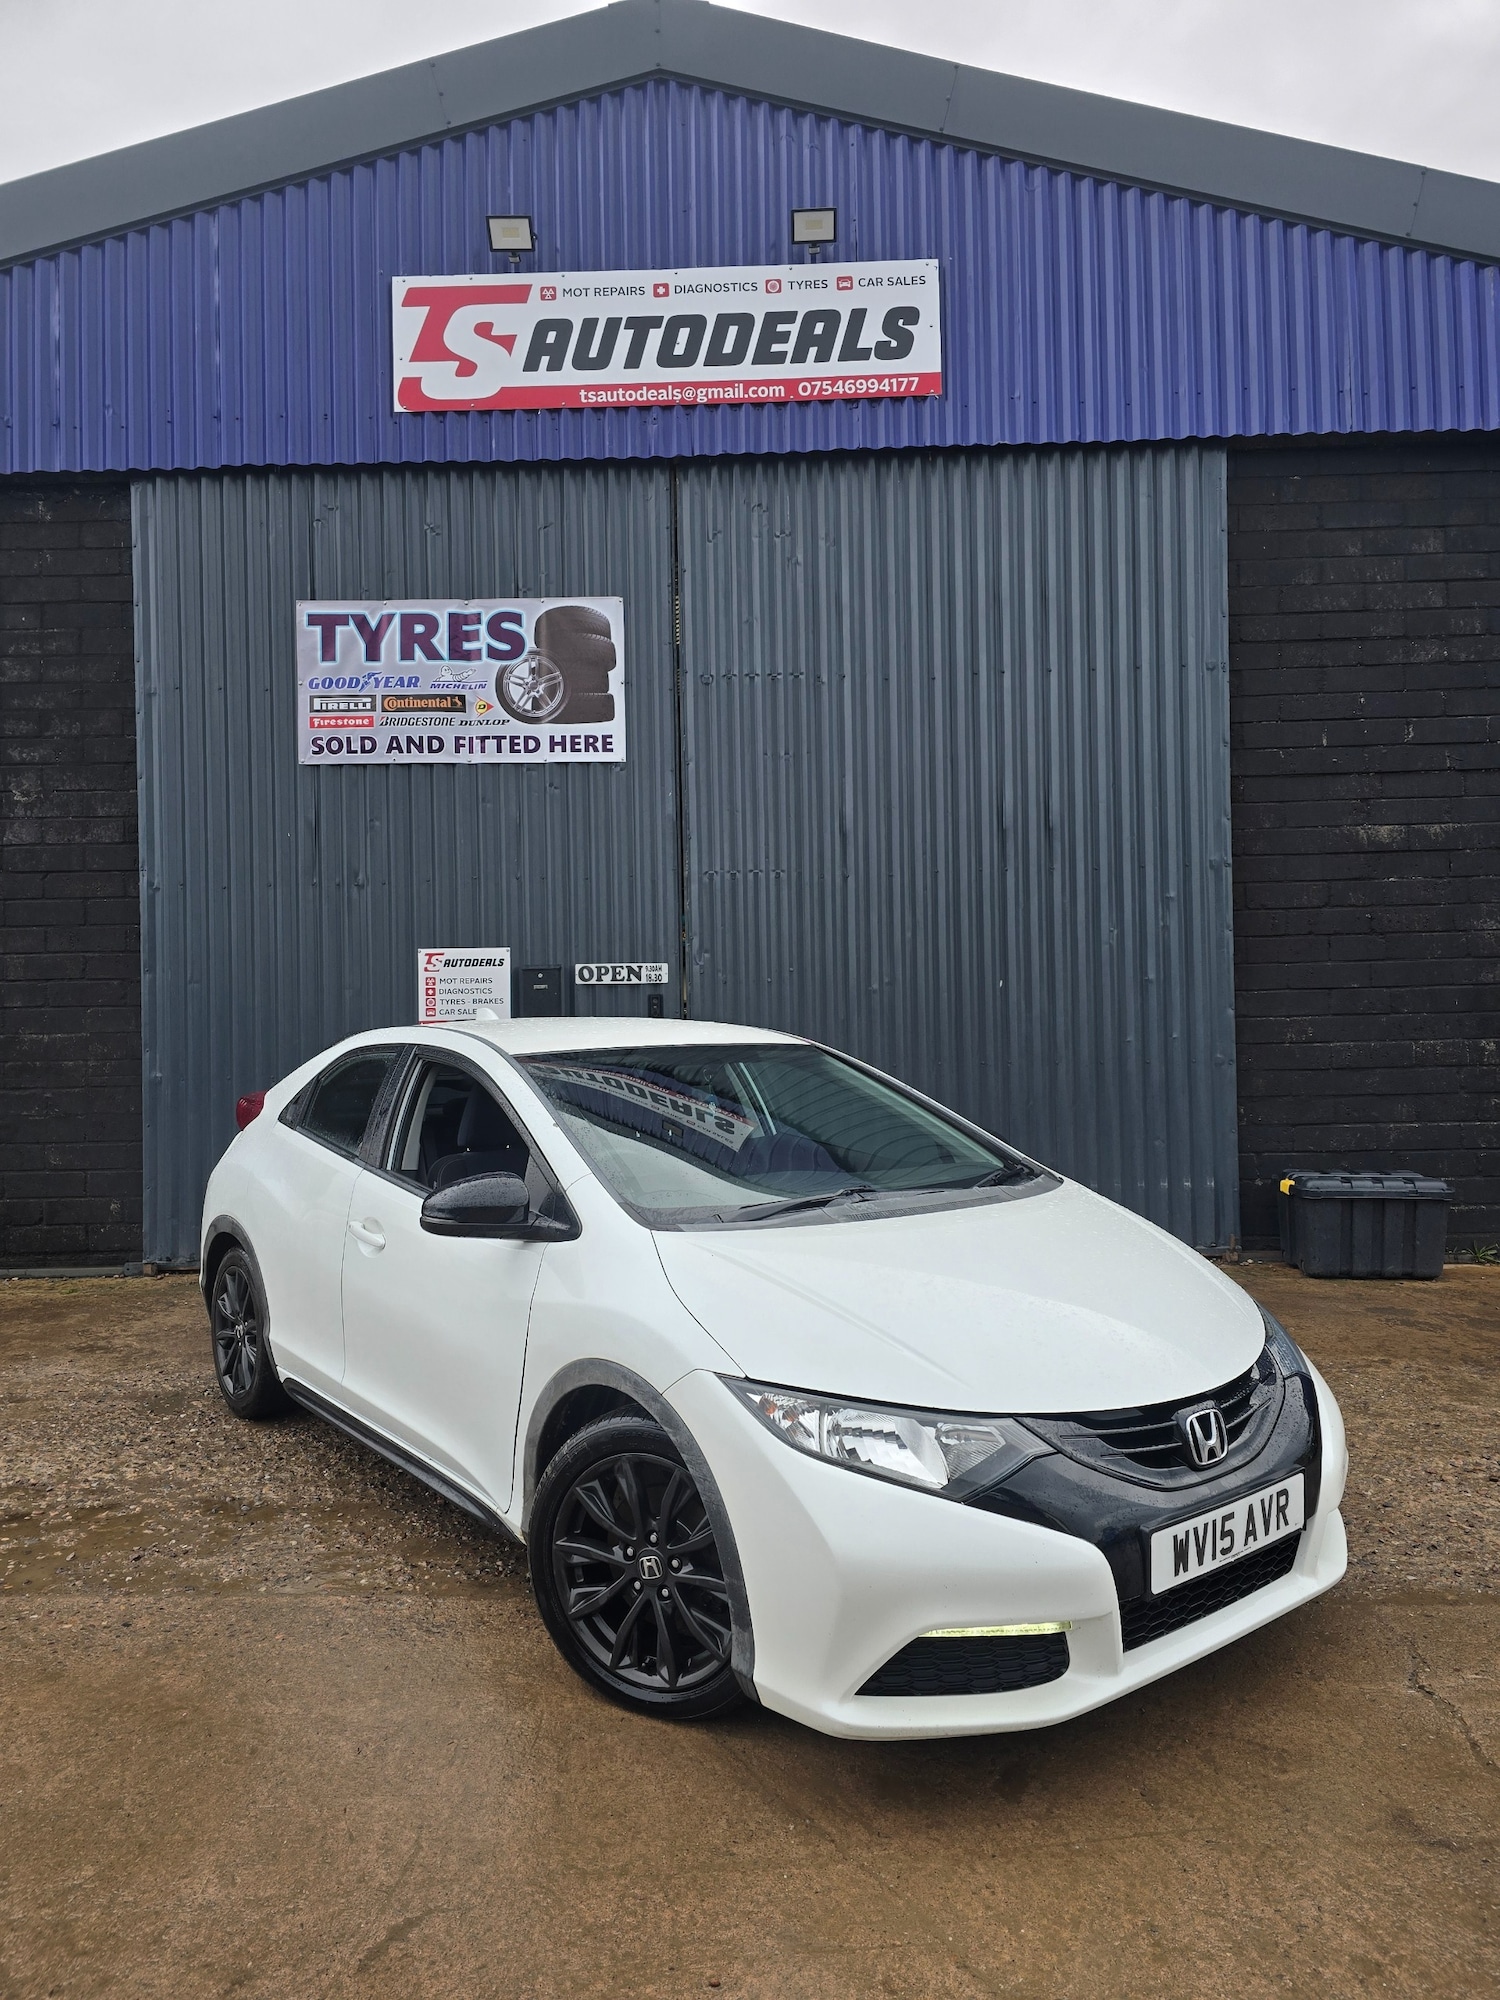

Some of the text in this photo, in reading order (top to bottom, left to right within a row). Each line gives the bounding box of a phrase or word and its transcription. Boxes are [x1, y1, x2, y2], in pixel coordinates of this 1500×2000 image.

[788, 279, 829, 291] TYRES
[858, 275, 926, 288] CAR SALES
[562, 286, 646, 298] MOT REPAIRS
[674, 282, 758, 295] DIAGNOSTICS
[522, 306, 920, 372] AUTODEALS
[579, 377, 919, 403] tsautodeals@gmail.com 07546994177
[306, 612, 526, 662] TYRES
[313, 697, 372, 711] PIRELLI
[383, 696, 452, 711] Continental
[312, 718, 370, 728] Firestone
[379, 716, 456, 727] BRIDGESTONE
[310, 734, 614, 755] SOLD AND FITTED HERE
[443, 958, 505, 968] AUTODEALS
[578, 965, 643, 983] OPEN
[439, 977, 458, 985] MOT
[439, 1008, 456, 1016] CAR
[1172, 1488, 1290, 1578] WV15 AVR
